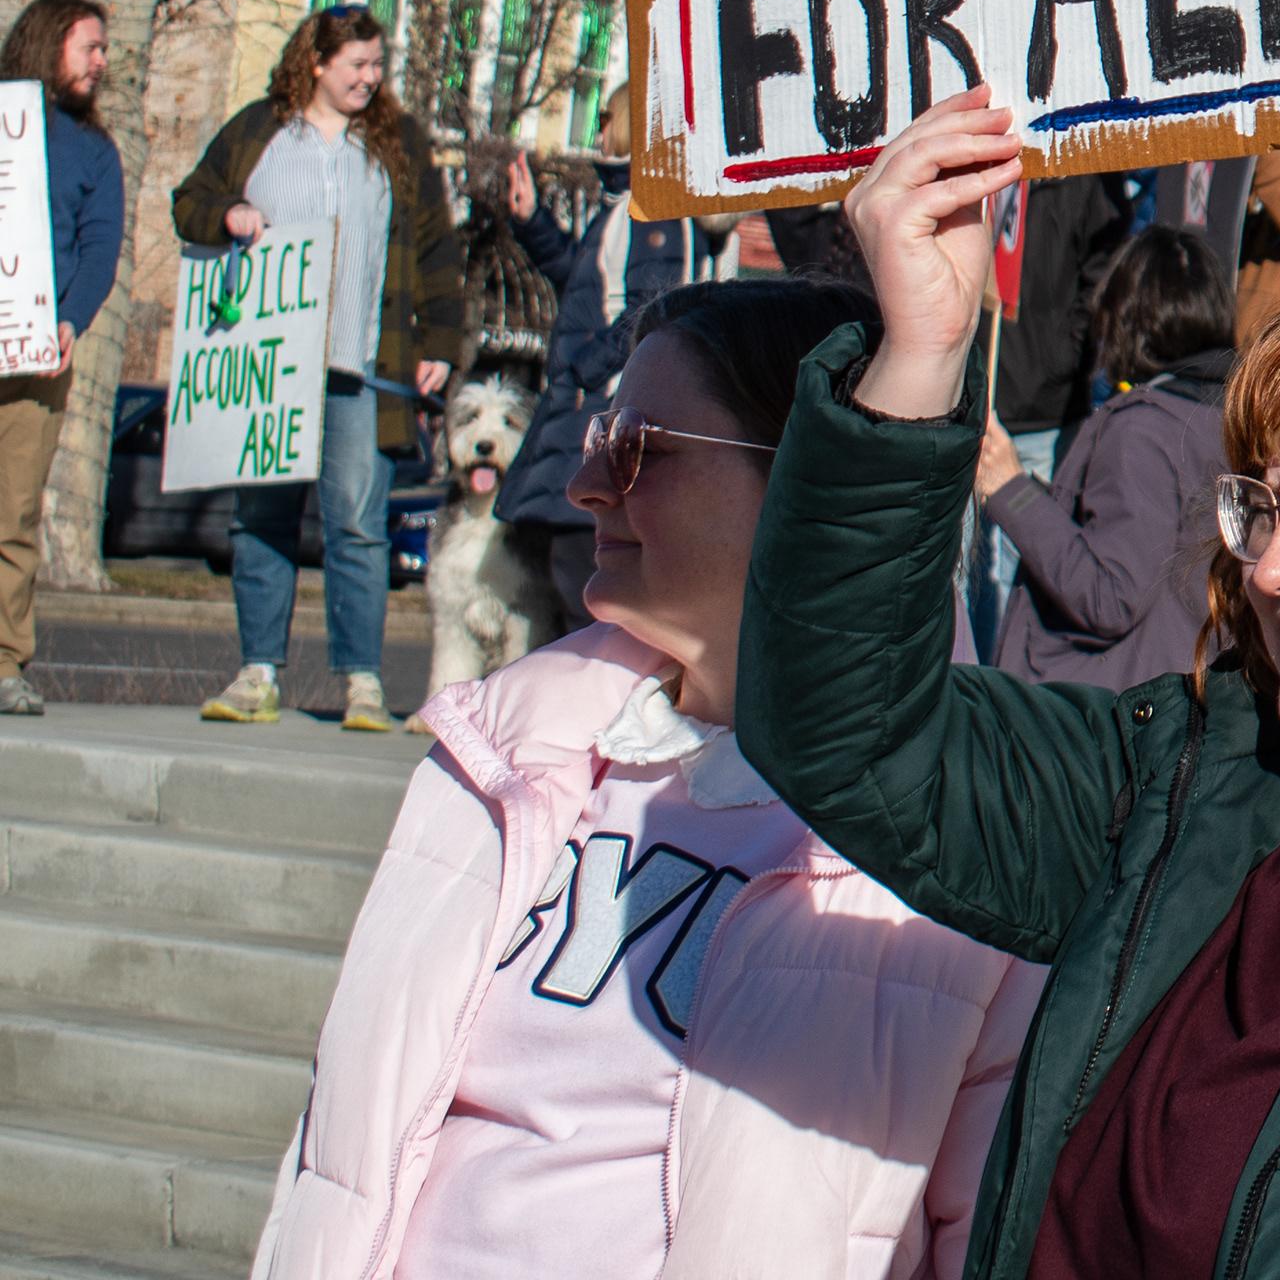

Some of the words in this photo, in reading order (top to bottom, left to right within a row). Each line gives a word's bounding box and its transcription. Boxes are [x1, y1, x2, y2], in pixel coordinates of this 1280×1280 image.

[185, 250, 254, 331] HOD
[171, 337, 298, 425] ACCOUNT-
[237, 403, 304, 477] ABLE
